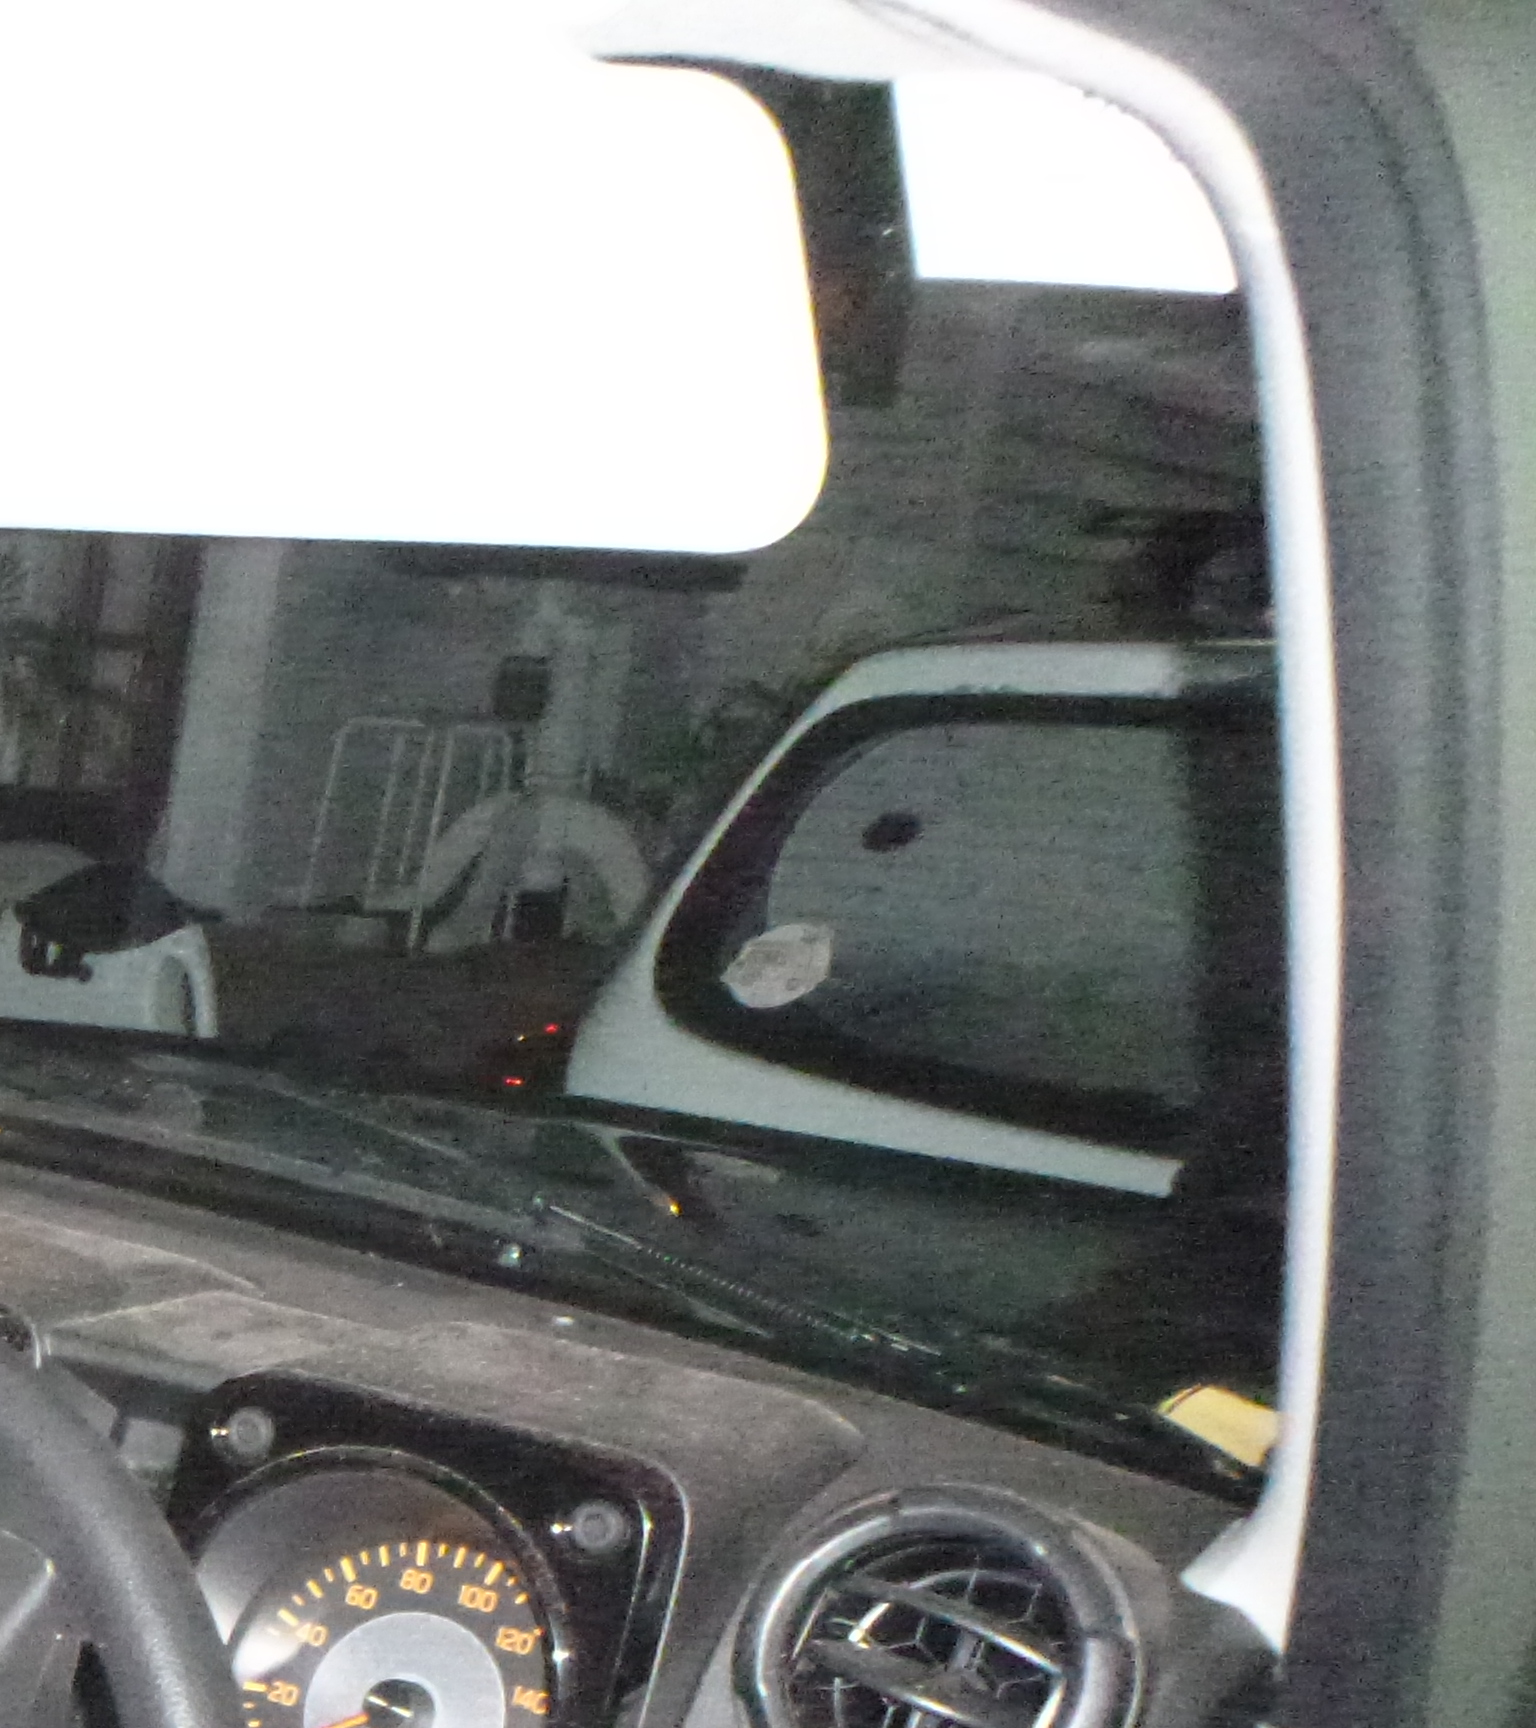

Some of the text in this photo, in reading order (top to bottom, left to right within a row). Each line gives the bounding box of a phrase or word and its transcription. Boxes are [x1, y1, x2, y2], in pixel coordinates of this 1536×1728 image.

[400, 1567, 434, 1594] 80
[345, 1584, 378, 1610] 60
[457, 1584, 498, 1613] 100
[296, 1622, 327, 1647] 40
[495, 1626, 536, 1655] 120
[267, 1680, 299, 1707] 20
